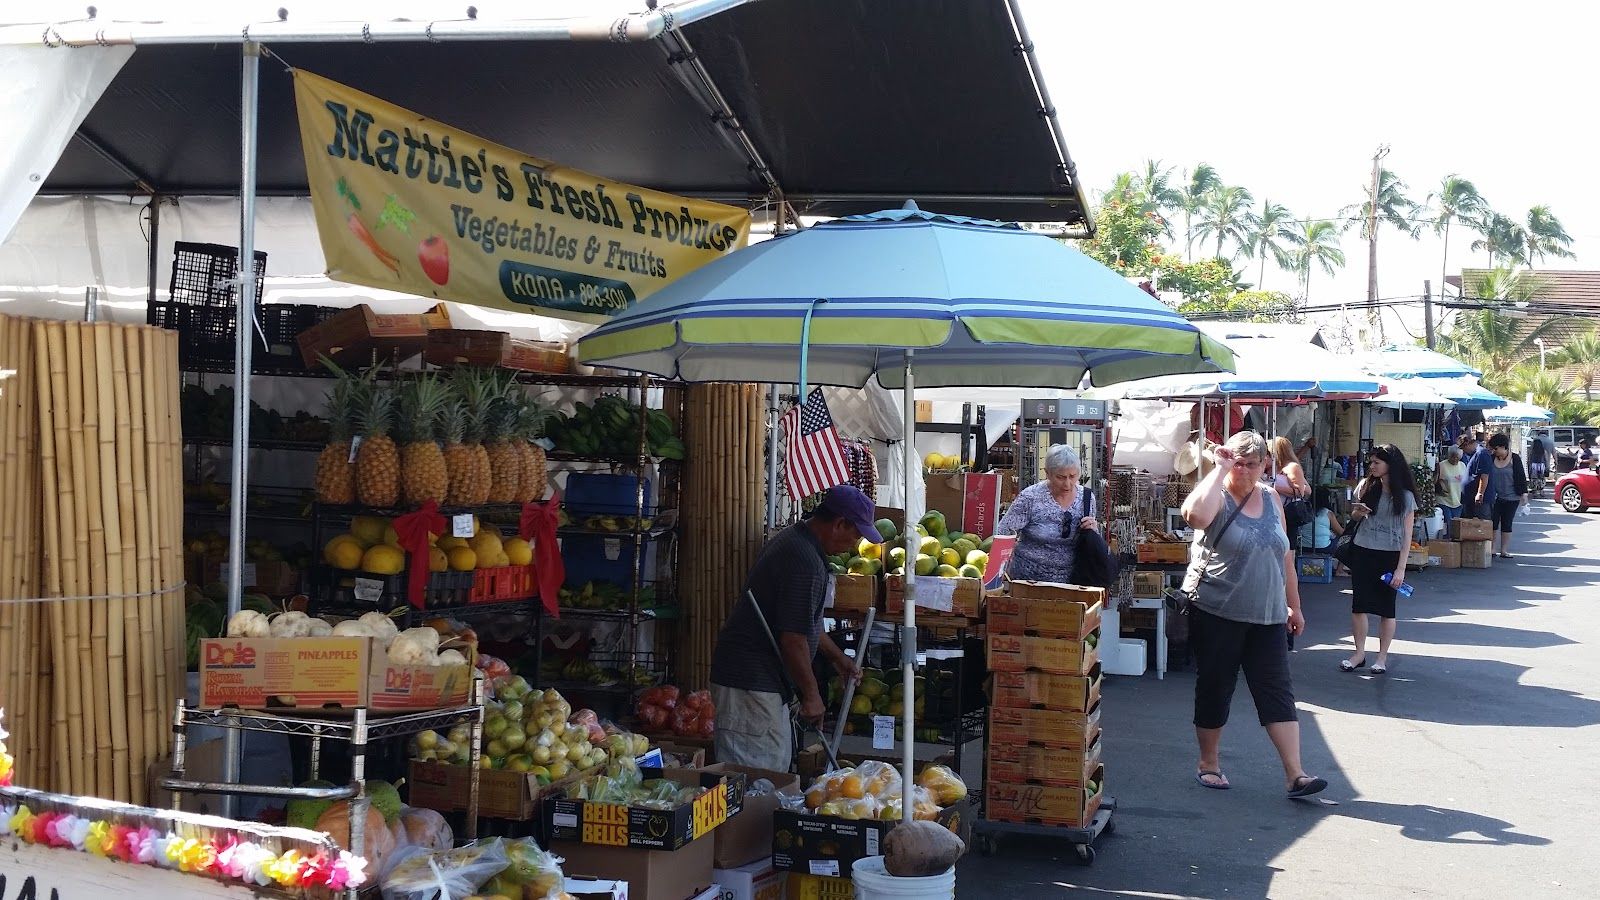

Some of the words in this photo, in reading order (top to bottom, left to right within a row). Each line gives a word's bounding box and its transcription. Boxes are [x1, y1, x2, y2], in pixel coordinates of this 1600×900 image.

[326, 100, 515, 202] Mattie's
[520, 162, 624, 229] Fresh
[626, 192, 738, 252] Produce
[451, 204, 579, 262] Vegetables
[583, 235, 601, 264] &
[604, 240, 667, 278] Fruits
[511, 271, 564, 301] KONA
[991, 599, 1018, 613] Dole
[206, 642, 256, 665] Dole
[298, 650, 358, 660] PINEAPPLES
[992, 637, 1020, 651] Dole
[386, 667, 411, 689] Dole
[998, 672, 1024, 686] Dole
[583, 803, 628, 825] BELLS
[693, 784, 727, 840] BELLS
[583, 823, 628, 846] BELLS
